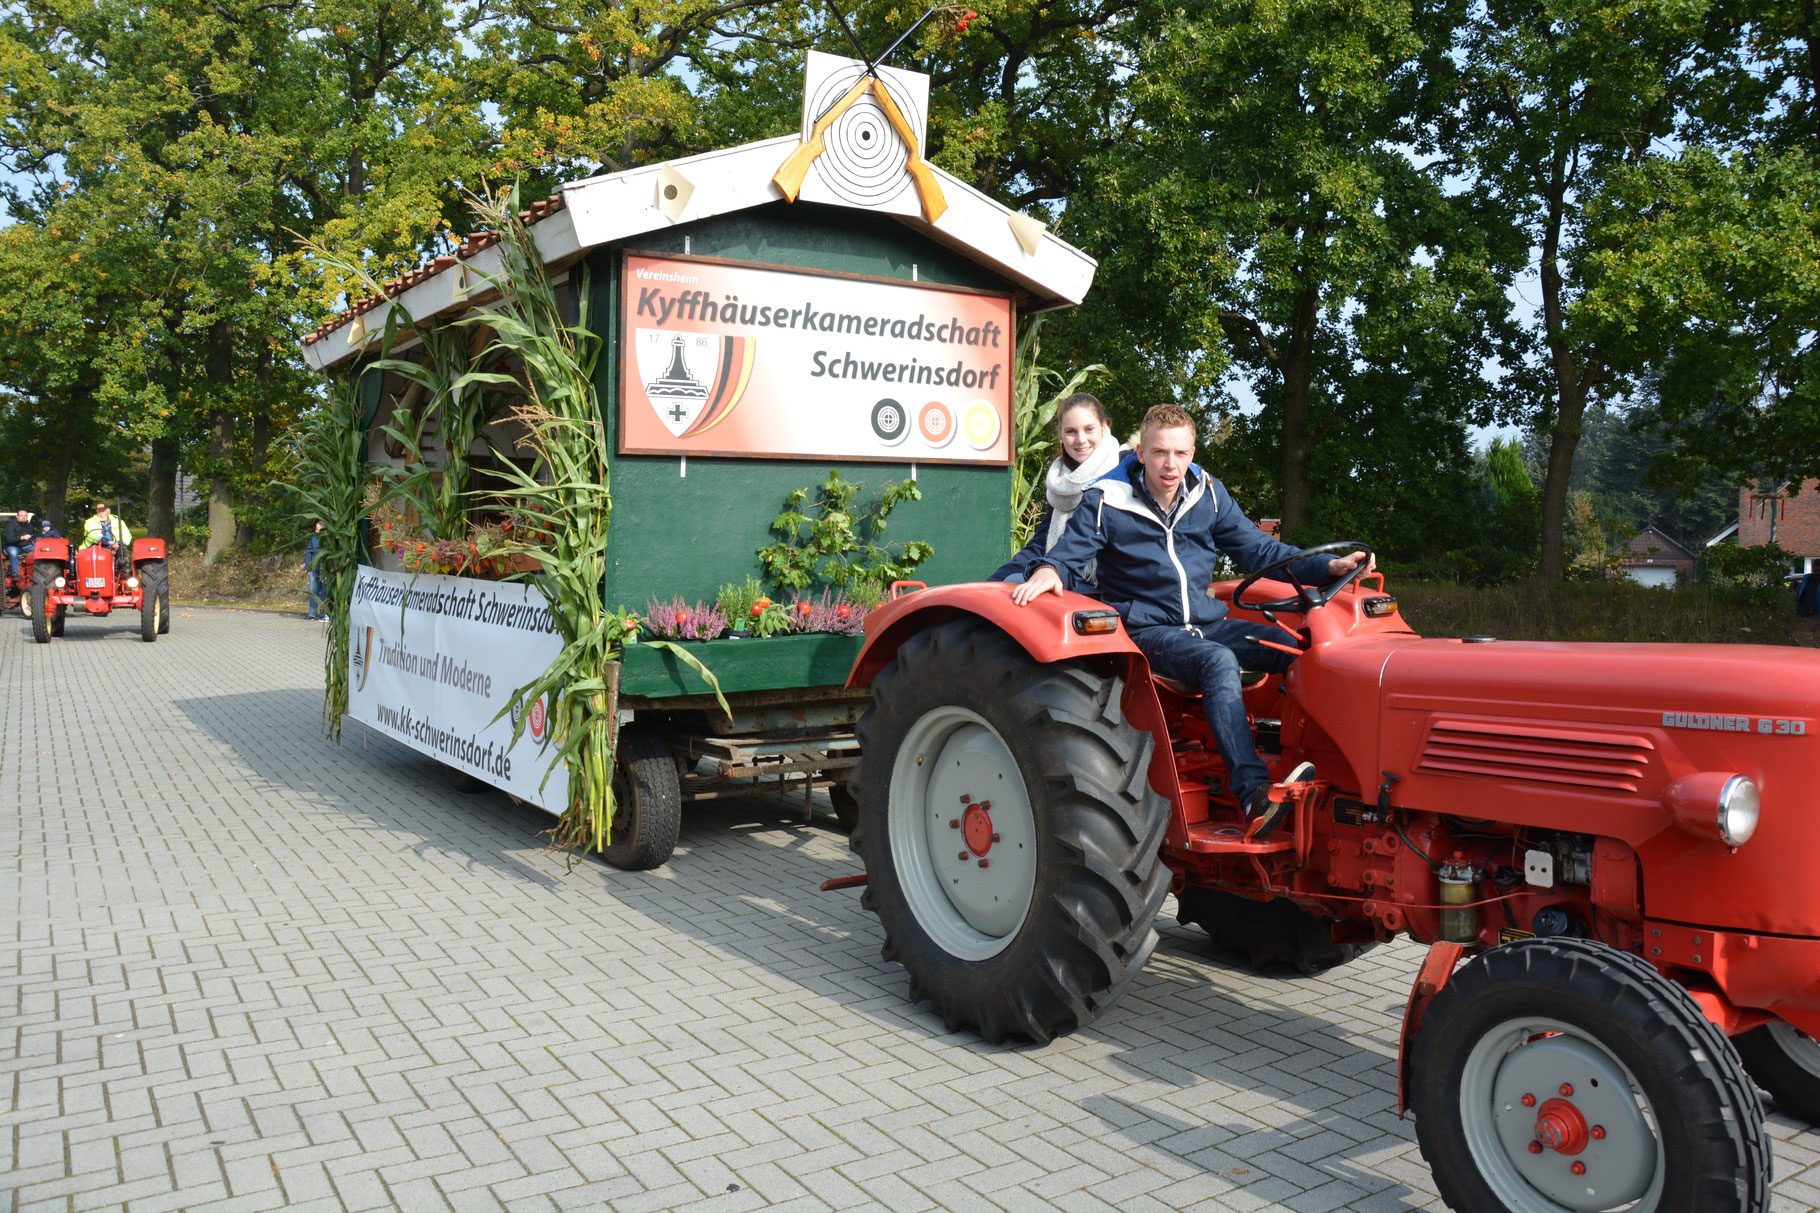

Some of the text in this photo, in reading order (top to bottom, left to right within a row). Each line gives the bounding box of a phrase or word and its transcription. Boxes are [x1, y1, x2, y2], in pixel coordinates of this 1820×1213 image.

[636, 268, 699, 284] Vereinsheim
[636, 287, 1001, 348] Kyffhäuserkameradschaft
[649, 334, 708, 347] 17 86
[810, 350, 1001, 389] Schwerinsdorf
[379, 638, 492, 698] Tradition und Moderne
[377, 703, 512, 781] www.kk-schwerinsdorf.de
